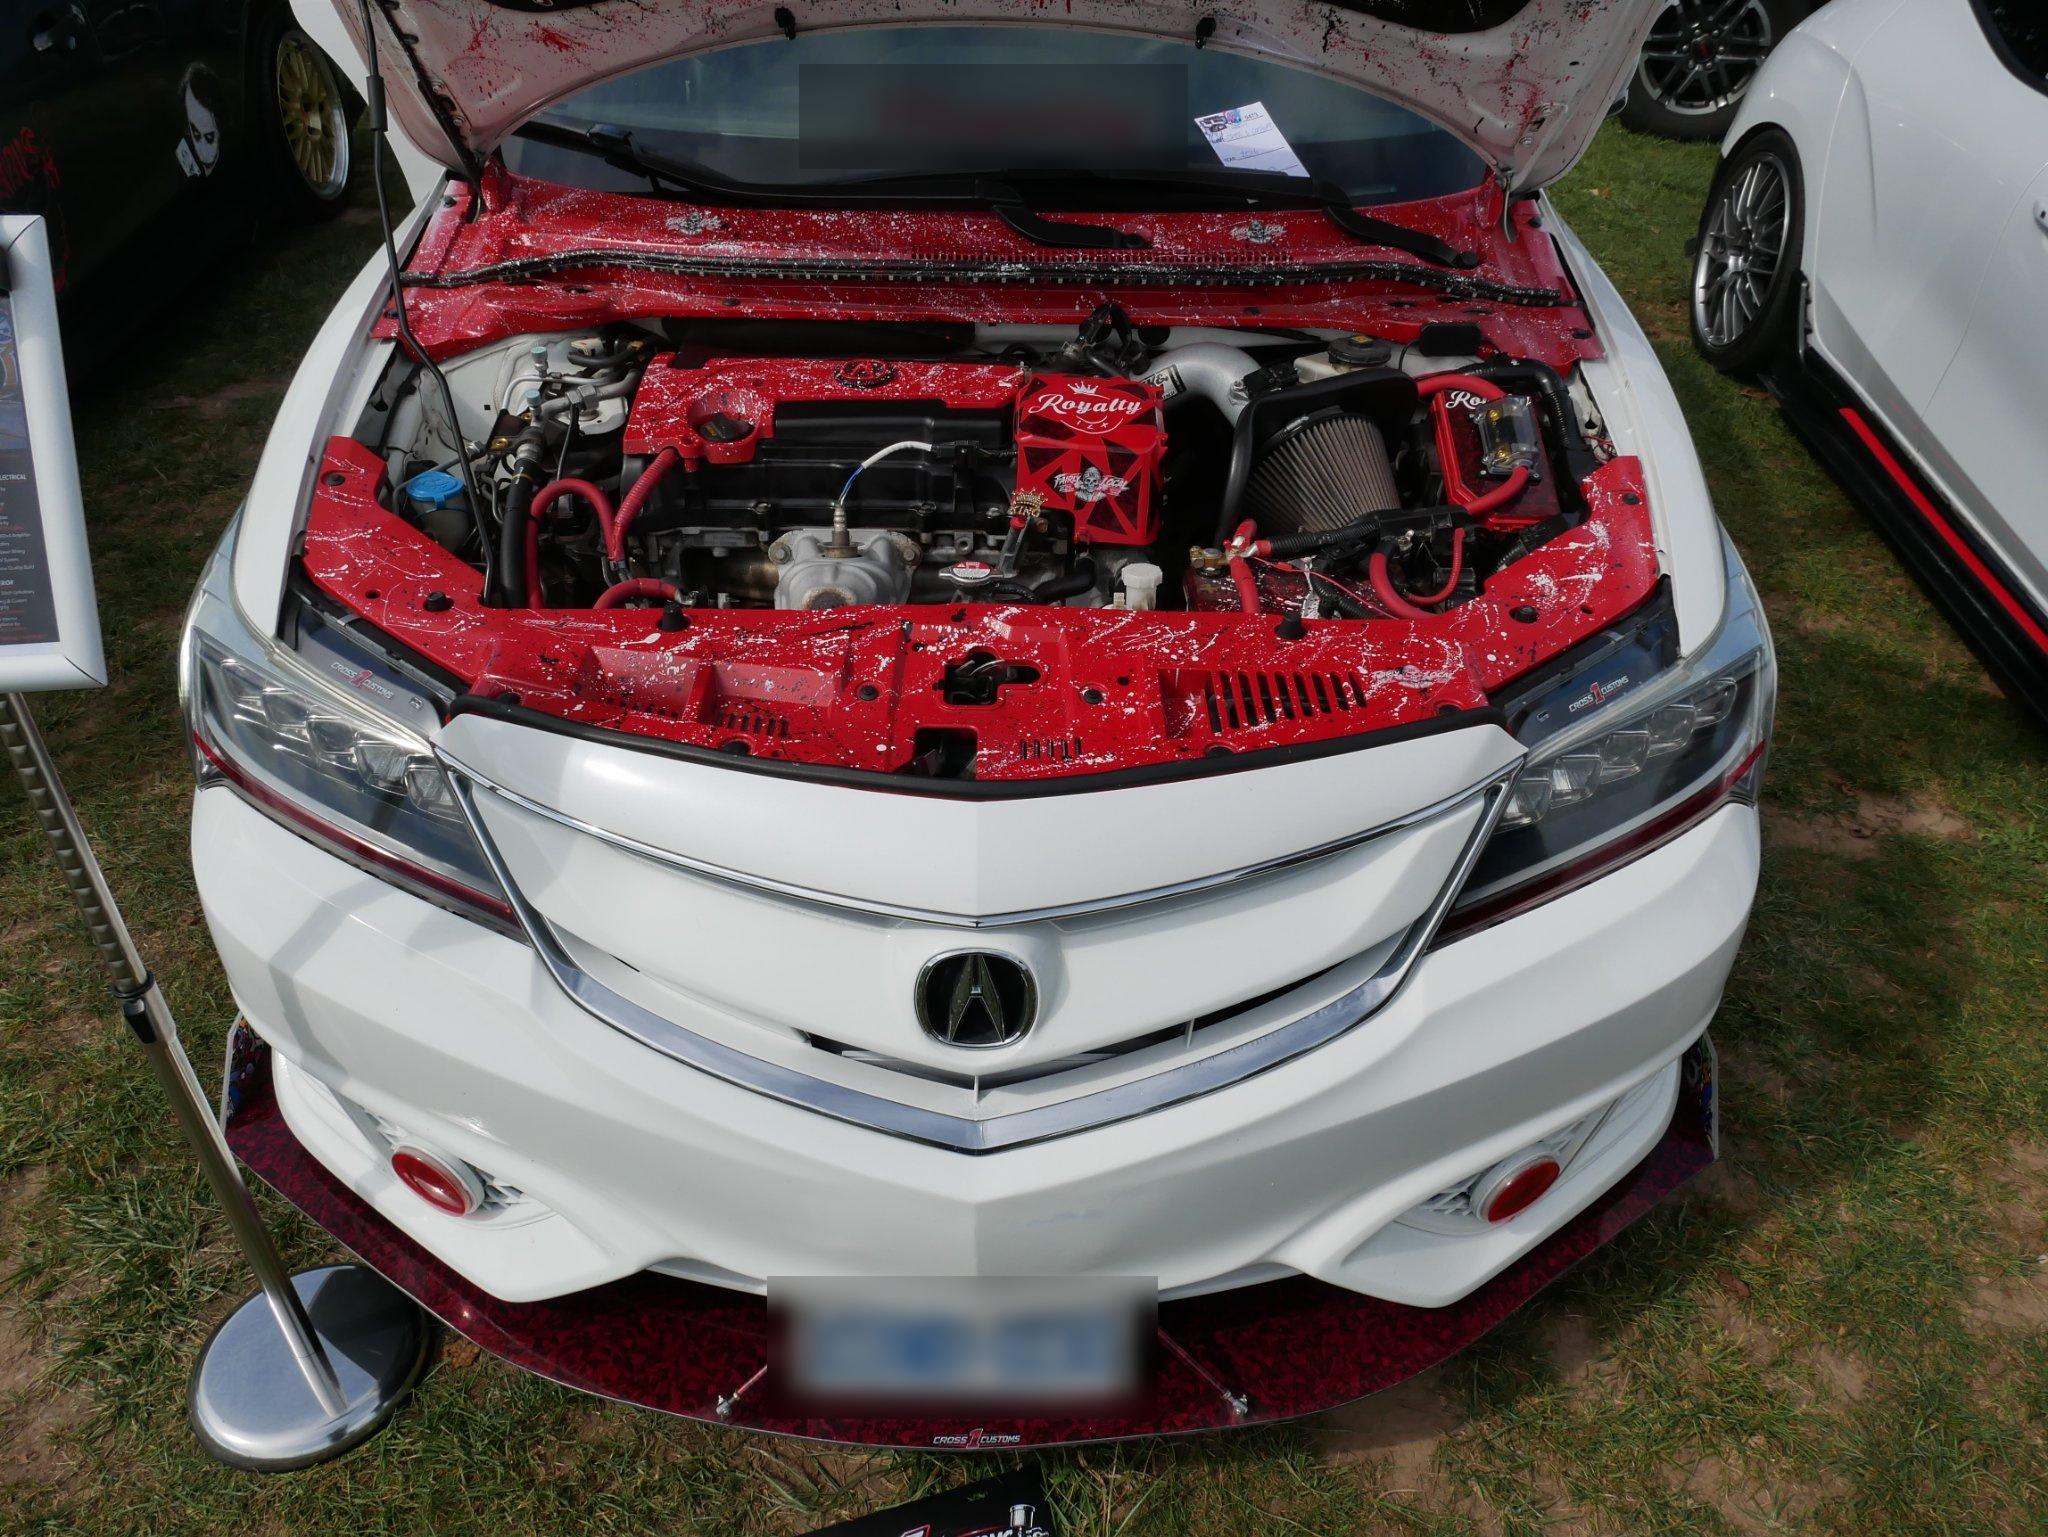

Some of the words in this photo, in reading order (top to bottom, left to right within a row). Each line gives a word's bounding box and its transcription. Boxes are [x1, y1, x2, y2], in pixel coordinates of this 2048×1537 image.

[1028, 393, 1142, 414] Royalty
[1054, 473, 1082, 488] FAIRLY
[1100, 474, 1130, 490] LOCAL
[330, 661, 358, 679] CROSS
[350, 669, 374, 687] 1
[362, 679, 395, 699] CUSTOMS
[1568, 694, 1594, 713] CROSS
[1590, 681, 1605, 704] 1
[1601, 675, 1629, 695] CUSTOMS
[933, 1436, 968, 1444] CROSS
[966, 1428, 983, 1448] 1
[980, 1435, 1021, 1443] CUSTOMS
